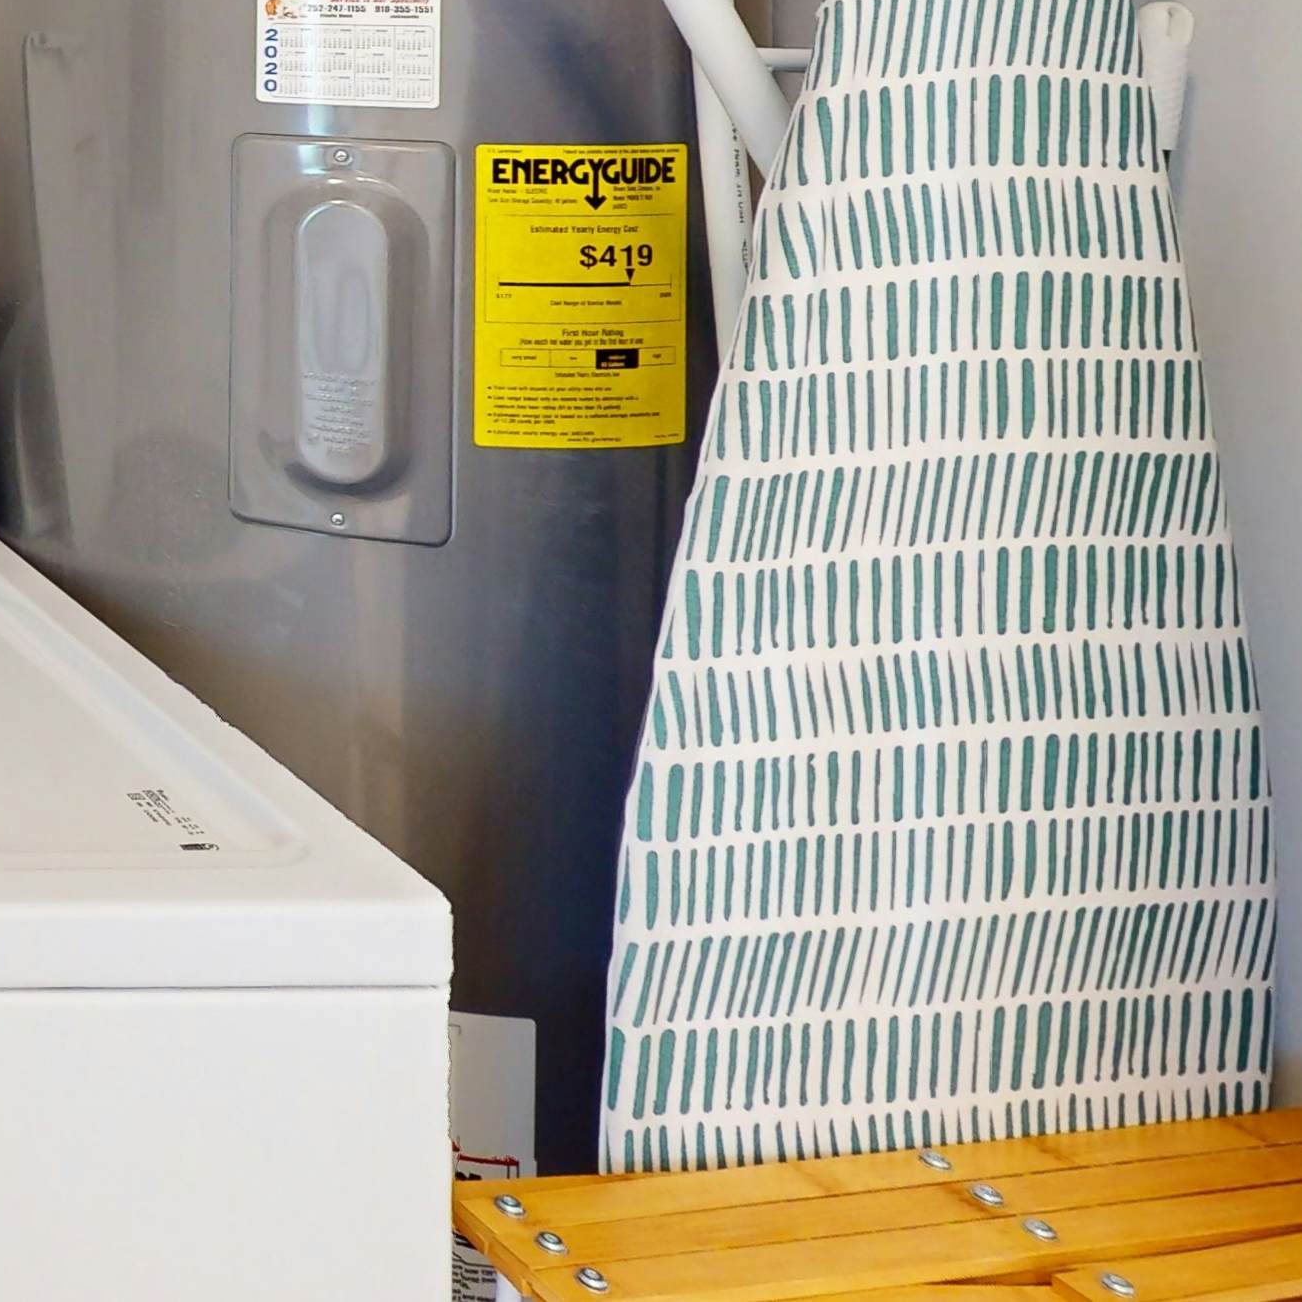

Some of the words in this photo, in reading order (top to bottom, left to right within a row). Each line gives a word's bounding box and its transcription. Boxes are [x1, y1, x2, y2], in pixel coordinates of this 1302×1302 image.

[492, 157, 676, 186] ENERGYGUIDE
[530, 225, 568, 234] Estimated
[571, 225, 595, 235] Yearly
[597, 225, 621, 235] Energy
[623, 224, 639, 233] Cost
[579, 243, 654, 270] $419
